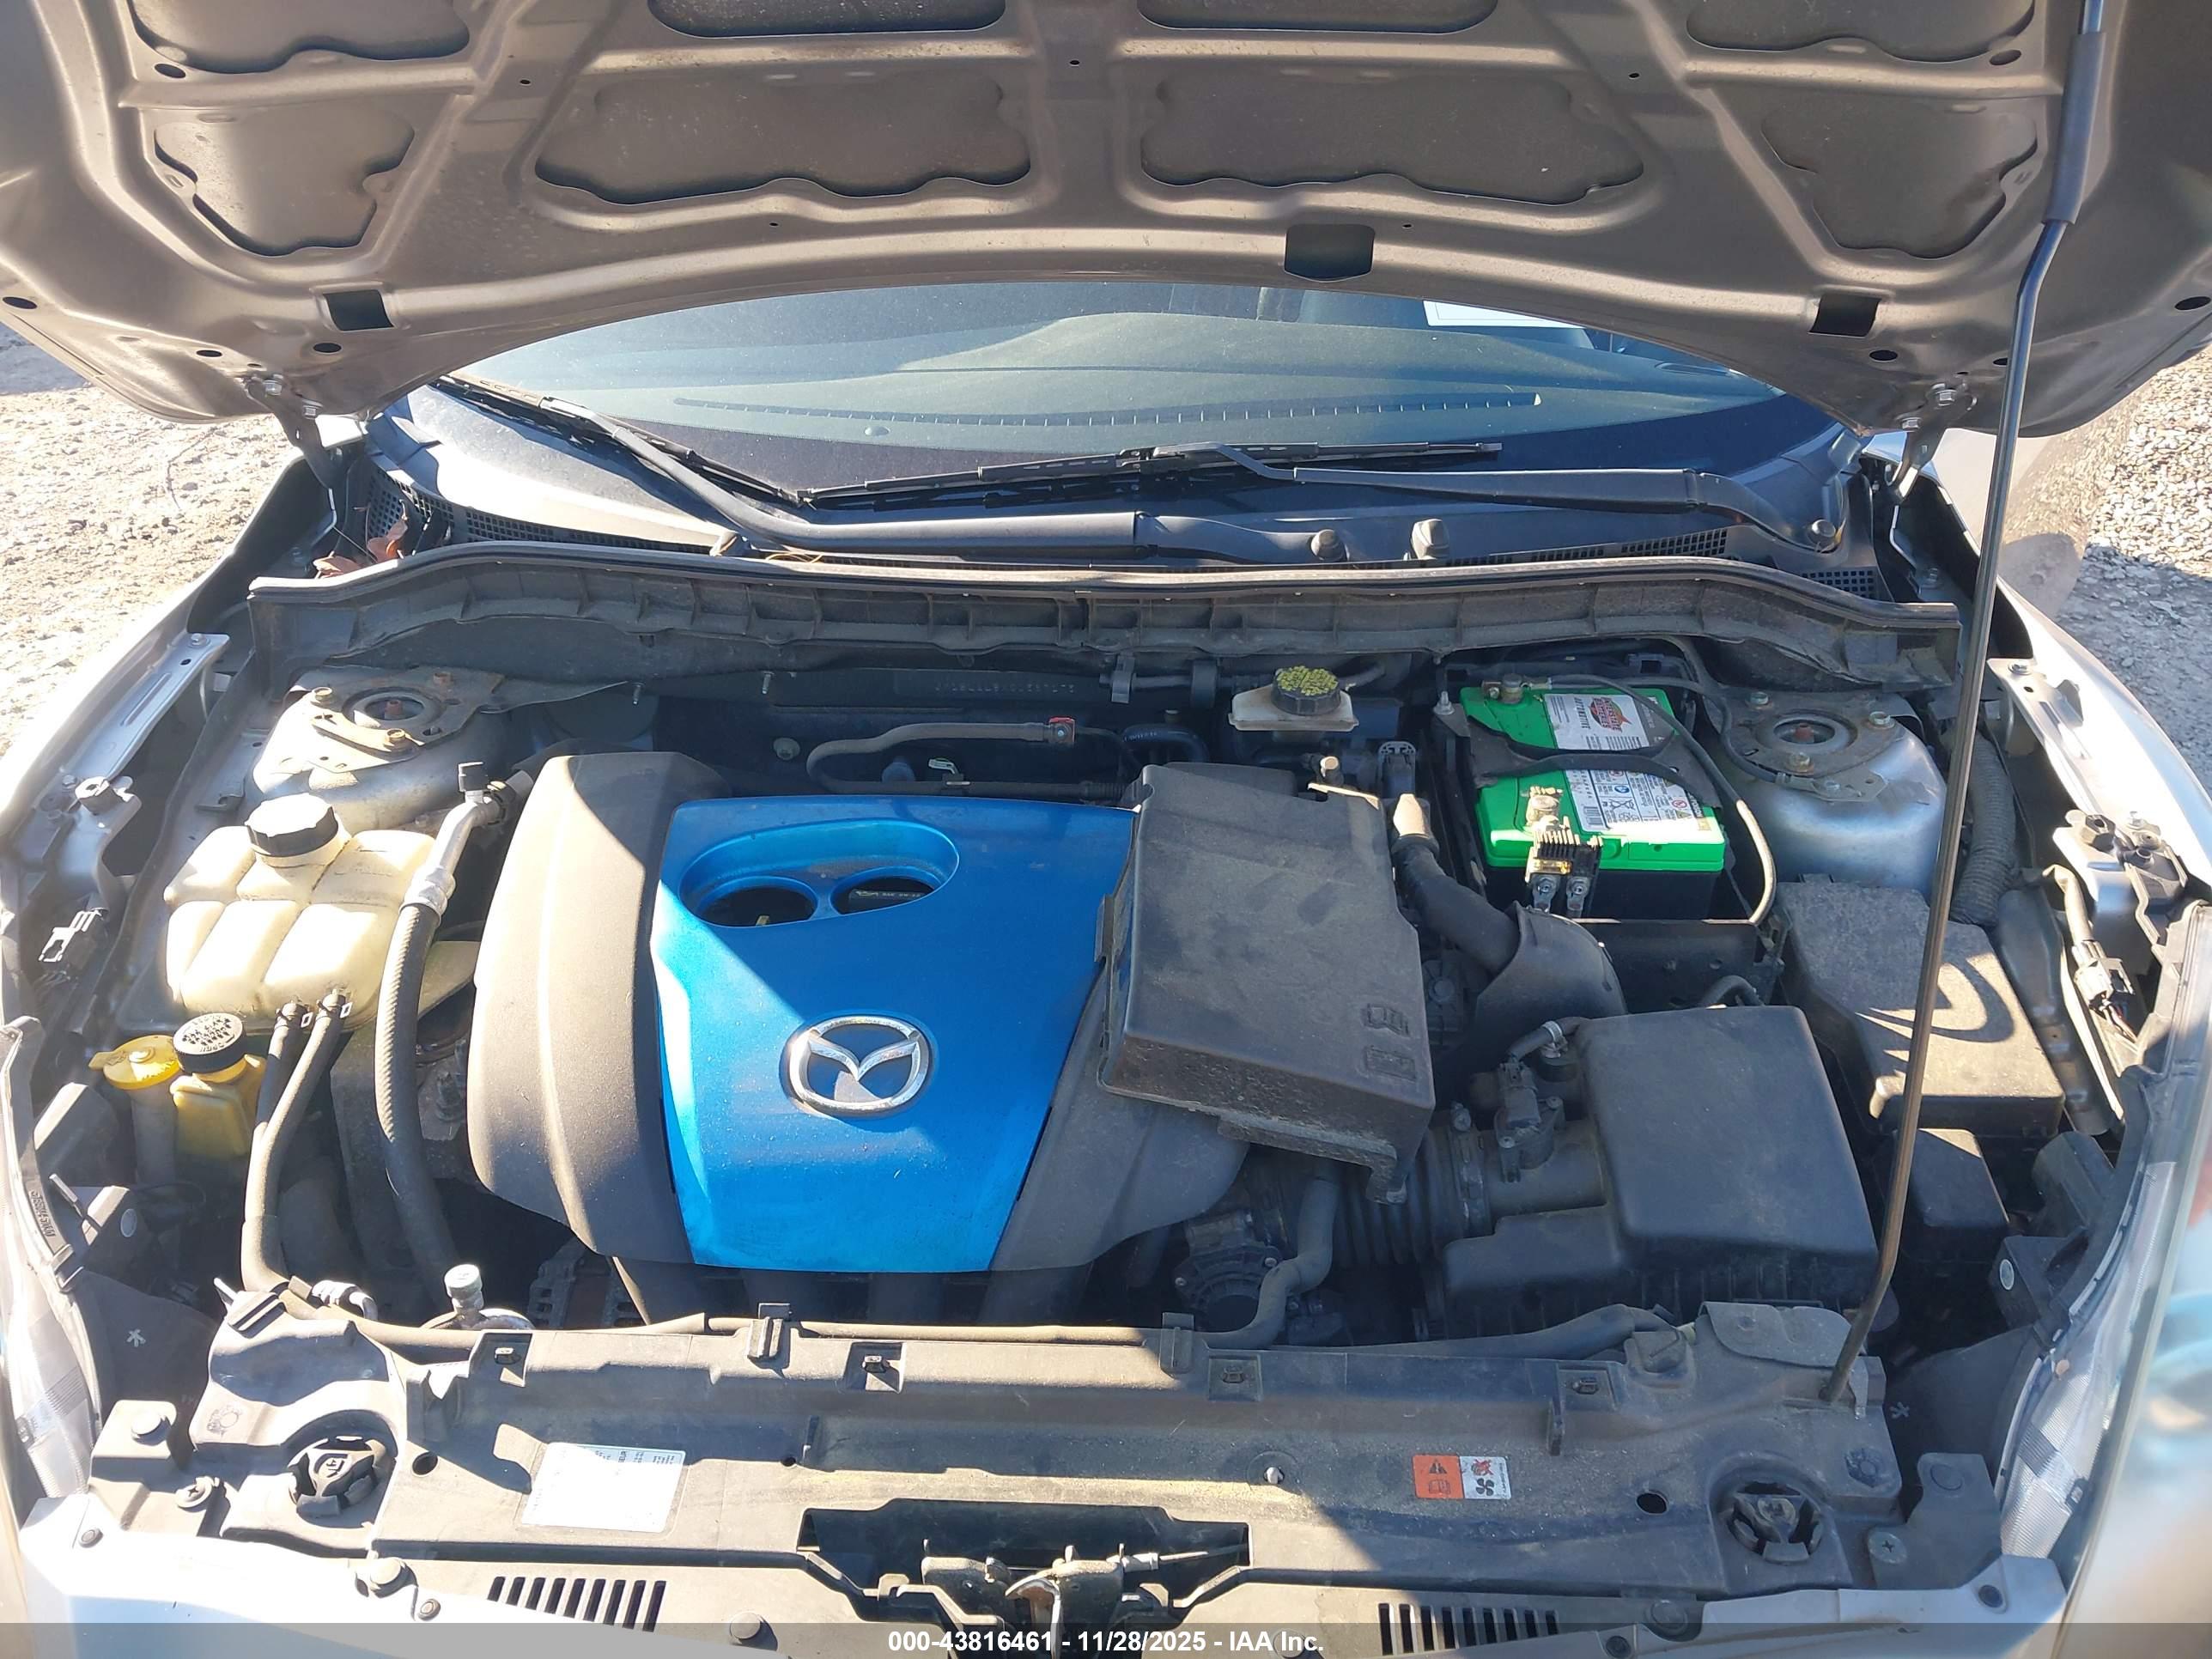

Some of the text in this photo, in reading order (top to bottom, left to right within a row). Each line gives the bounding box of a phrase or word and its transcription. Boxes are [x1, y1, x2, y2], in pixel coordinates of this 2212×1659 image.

[1573, 696, 1591, 730] AUTOMOTIVE
[1592, 696, 1610, 729] BATTERIES
[1601, 696, 1623, 733] INTERSTATE
